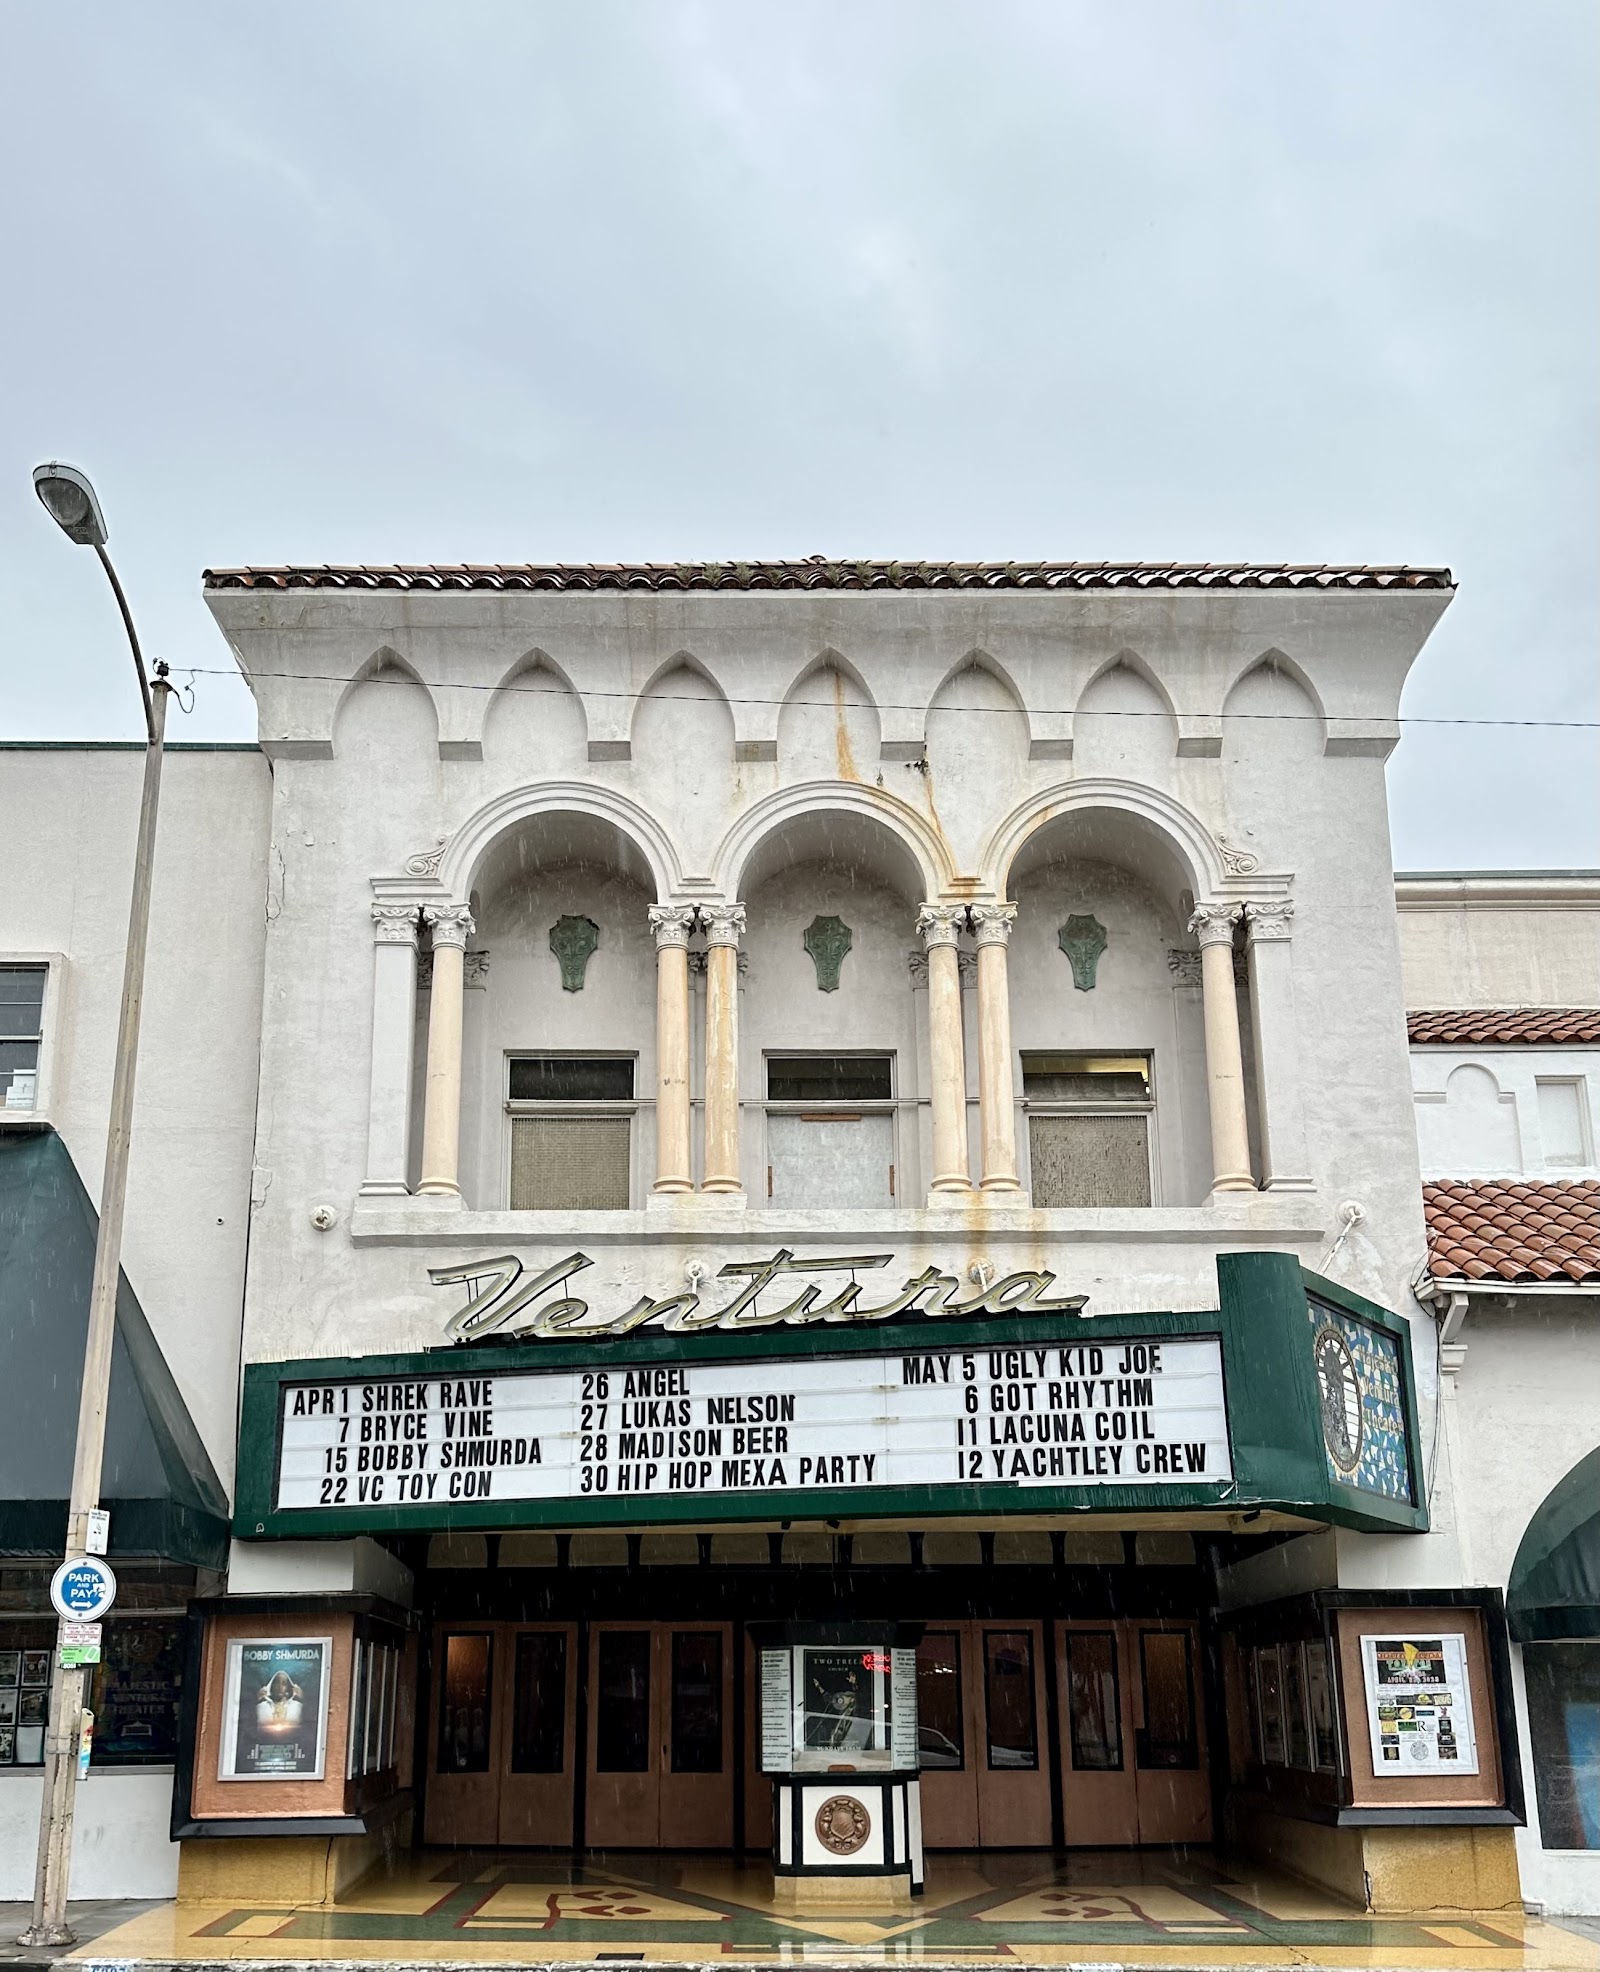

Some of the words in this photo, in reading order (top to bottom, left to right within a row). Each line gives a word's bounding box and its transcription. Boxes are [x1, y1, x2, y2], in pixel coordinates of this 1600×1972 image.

[427, 1248, 1090, 1343] Ventura
[902, 1355, 951, 1385] MAY
[962, 1354, 975, 1381] 5
[989, 1349, 1048, 1380] UGLY
[1059, 1347, 1103, 1377] KID
[1119, 1344, 1162, 1375] JOE
[293, 1389, 334, 1415] APR
[342, 1388, 348, 1412] 1
[362, 1384, 428, 1412] SHREK
[440, 1380, 493, 1408] RAVE
[582, 1372, 609, 1400] 26
[623, 1369, 690, 1399] ANGEL
[965, 1385, 978, 1414] 6
[990, 1382, 1037, 1412] GOT
[1049, 1378, 1153, 1410] RHYTHM
[1362, 1376, 1399, 1408] Ventura
[339, 1418, 350, 1443] 7
[360, 1413, 427, 1442] BRYCE
[444, 1410, 493, 1437] VINE
[580, 1404, 608, 1430] 27
[621, 1399, 691, 1429] LUKAS
[707, 1394, 796, 1425] NELSON
[957, 1418, 977, 1446] 11
[990, 1413, 1086, 1445] LACUNA
[1095, 1411, 1155, 1441] COIL
[325, 1447, 347, 1473] 15
[357, 1444, 428, 1472] BOBBY
[440, 1438, 542, 1468] SHMURDA
[580, 1434, 608, 1461] 28
[619, 1429, 721, 1459] MADISON
[732, 1426, 788, 1455] BEER
[958, 1450, 983, 1479] 12
[992, 1445, 1123, 1478] YACHTLEY
[1136, 1443, 1206, 1474] CREW
[320, 1478, 348, 1504] 22
[358, 1476, 384, 1502] VC
[397, 1474, 438, 1500] TOY
[450, 1471, 492, 1498] CON
[580, 1465, 608, 1493] 30
[618, 1463, 658, 1491] HIP
[669, 1460, 712, 1489] HOP
[722, 1457, 787, 1487] MEXA
[799, 1454, 876, 1485] PARTY
[68, 1573, 99, 1583] PARK
[70, 1590, 93, 1599] PAY
[244, 1650, 274, 1660] BOBBY
[275, 1649, 320, 1660] SHMURDA
